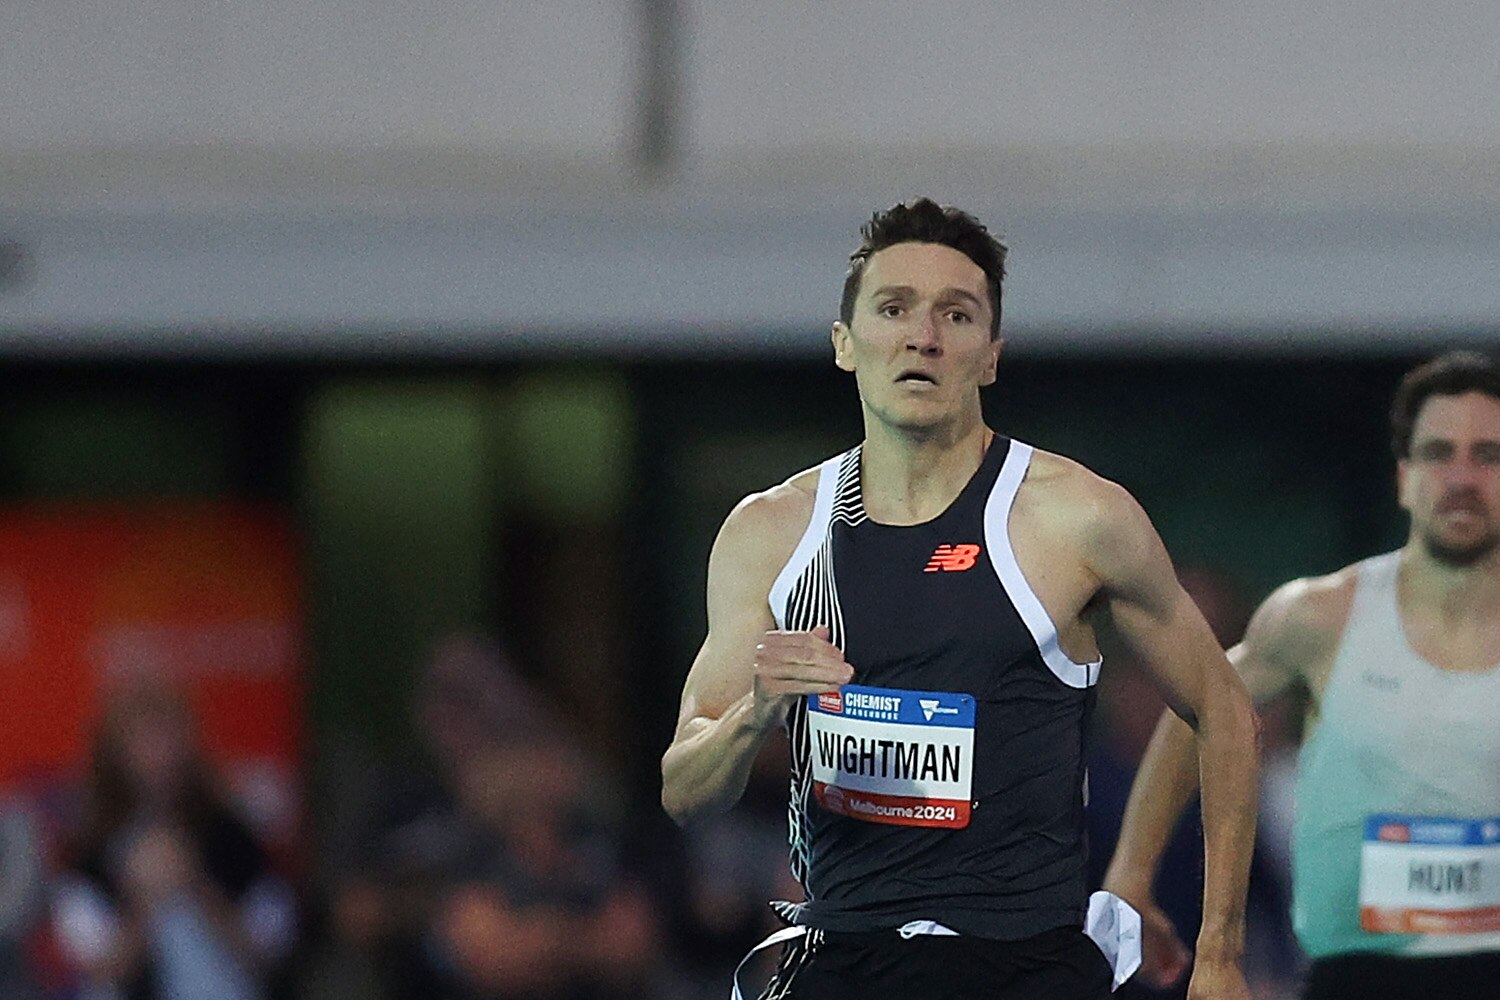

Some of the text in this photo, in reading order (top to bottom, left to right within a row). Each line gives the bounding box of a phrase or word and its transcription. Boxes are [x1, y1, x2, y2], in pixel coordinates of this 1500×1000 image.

[845, 692, 902, 712] CHEMIST
[817, 729, 961, 783] WIGHTMAN
[850, 797, 956, 821] Melbourne2024
[1408, 860, 1480, 895] HUNT
